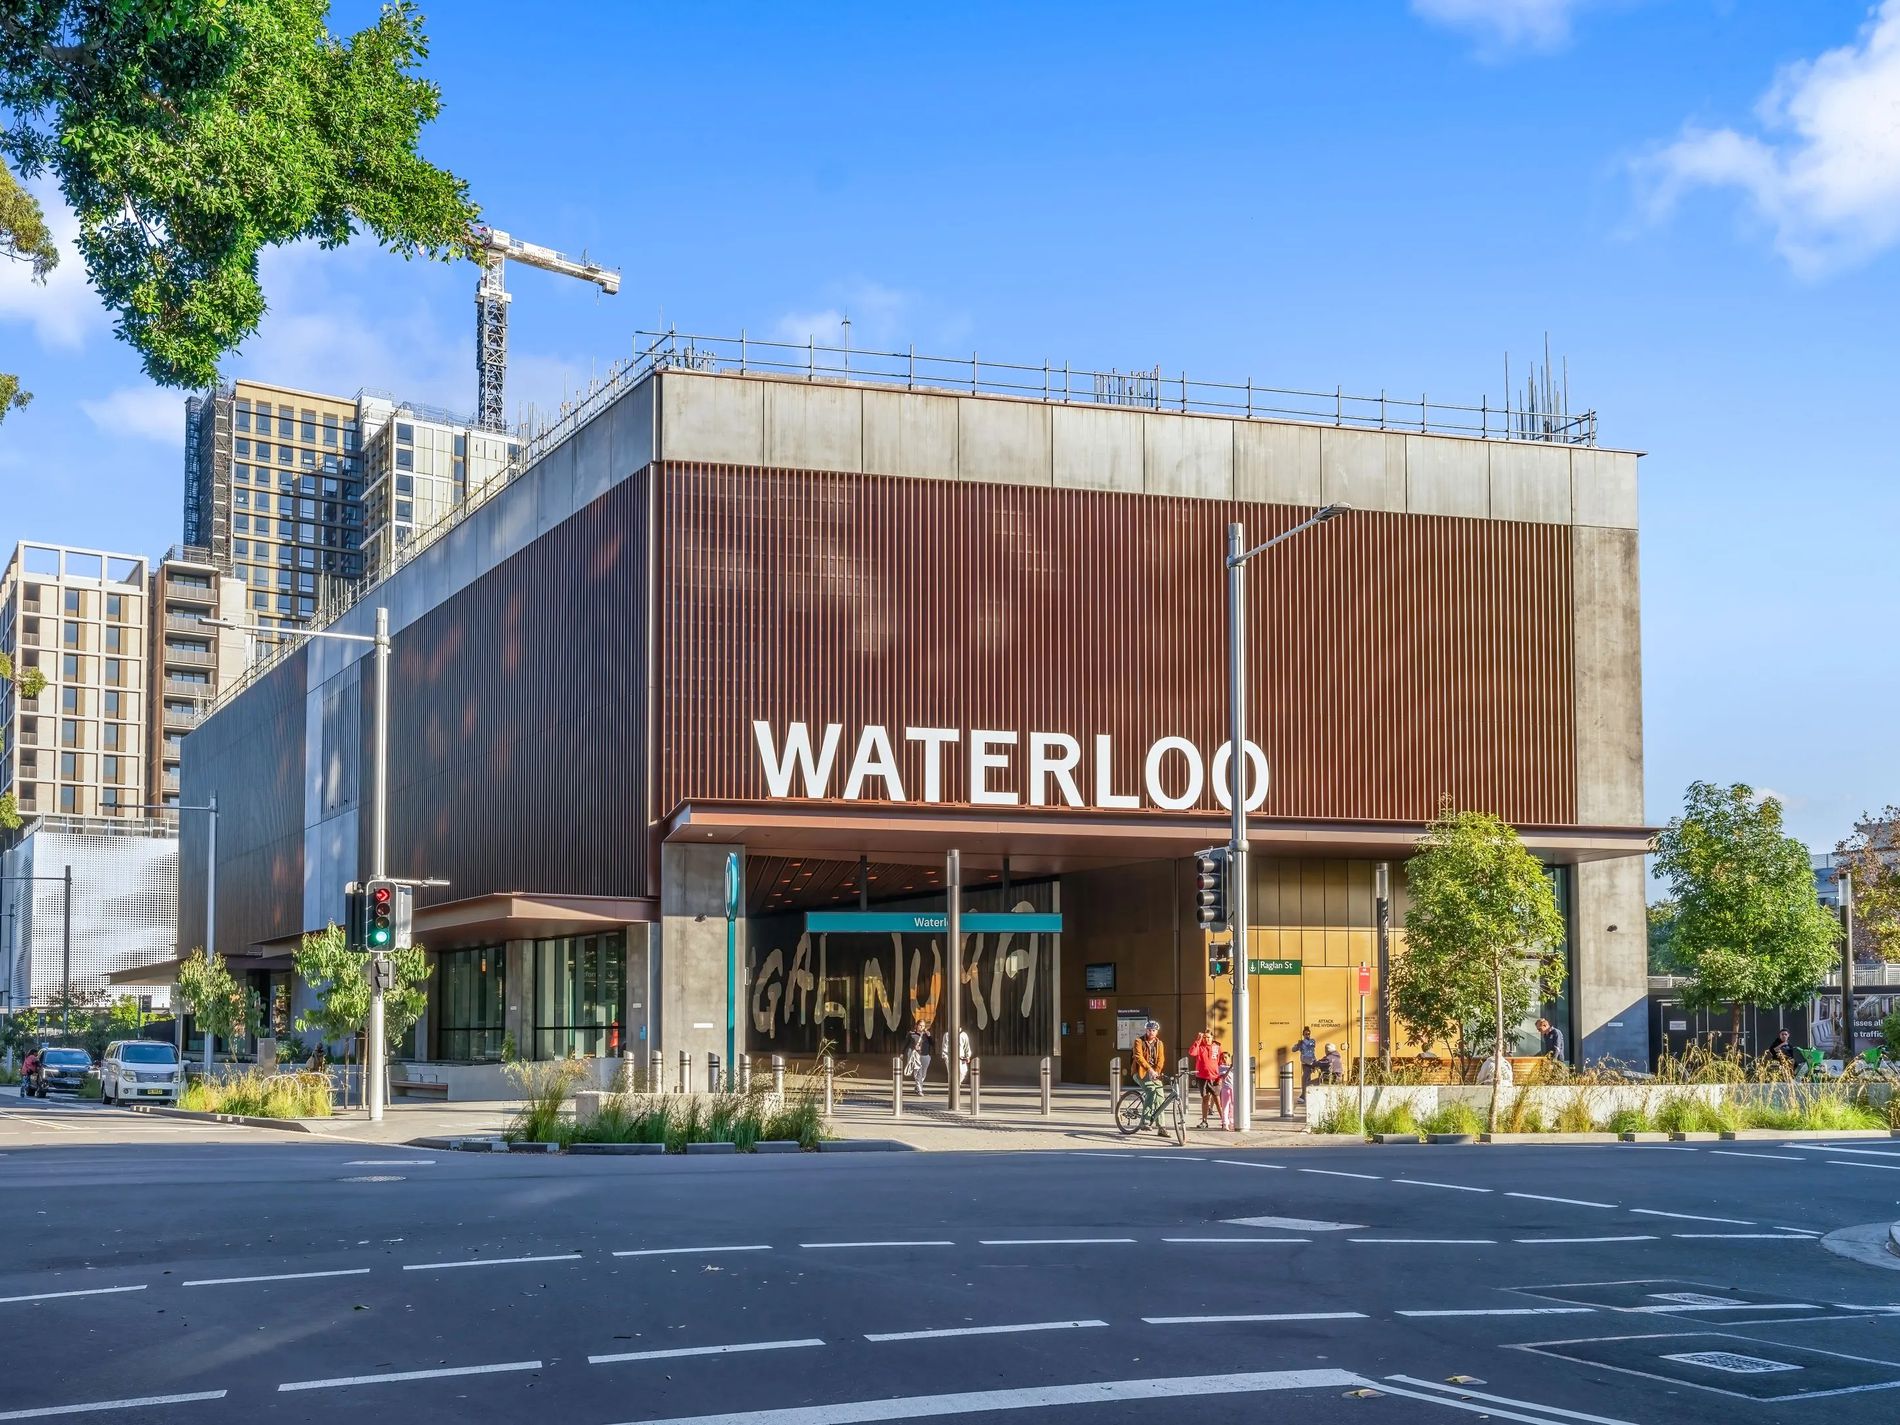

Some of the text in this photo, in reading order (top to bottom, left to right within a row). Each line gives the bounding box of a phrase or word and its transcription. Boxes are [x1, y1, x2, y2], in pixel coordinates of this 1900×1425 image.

[753, 720, 1270, 812] WATERLOO
[914, 917, 949, 927] Waterl
[1260, 961, 1293, 971] Raglan St
[1853, 1019, 1872, 1027] isses
[1860, 1030, 1884, 1038] traffic
